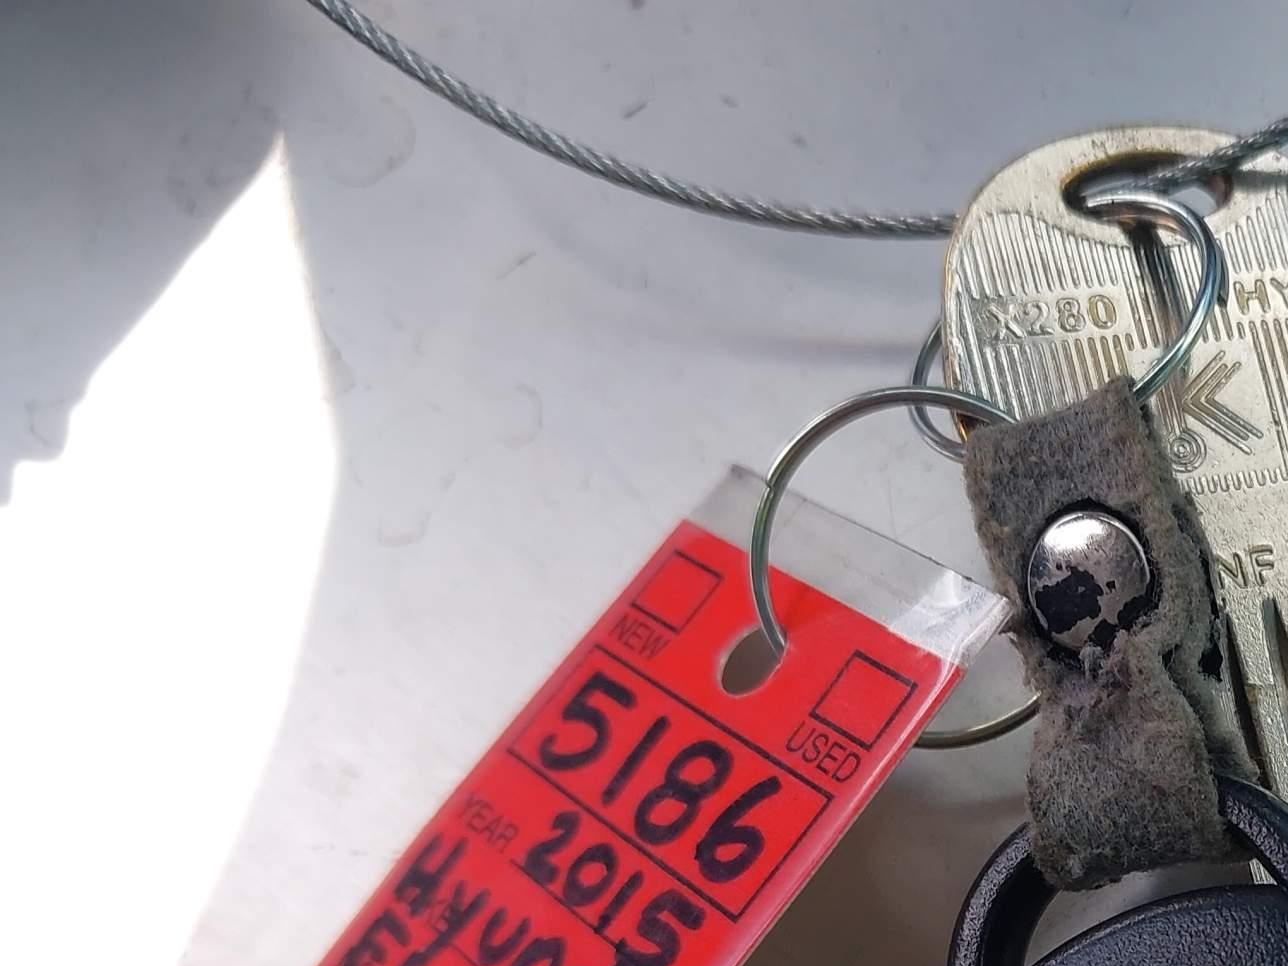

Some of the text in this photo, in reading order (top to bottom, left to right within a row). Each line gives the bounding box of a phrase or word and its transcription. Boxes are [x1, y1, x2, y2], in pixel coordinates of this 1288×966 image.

[608, 614, 670, 661] NEW
[538, 670, 782, 884] 5186
[785, 722, 863, 785] USED
[459, 795, 520, 854] YEAR
